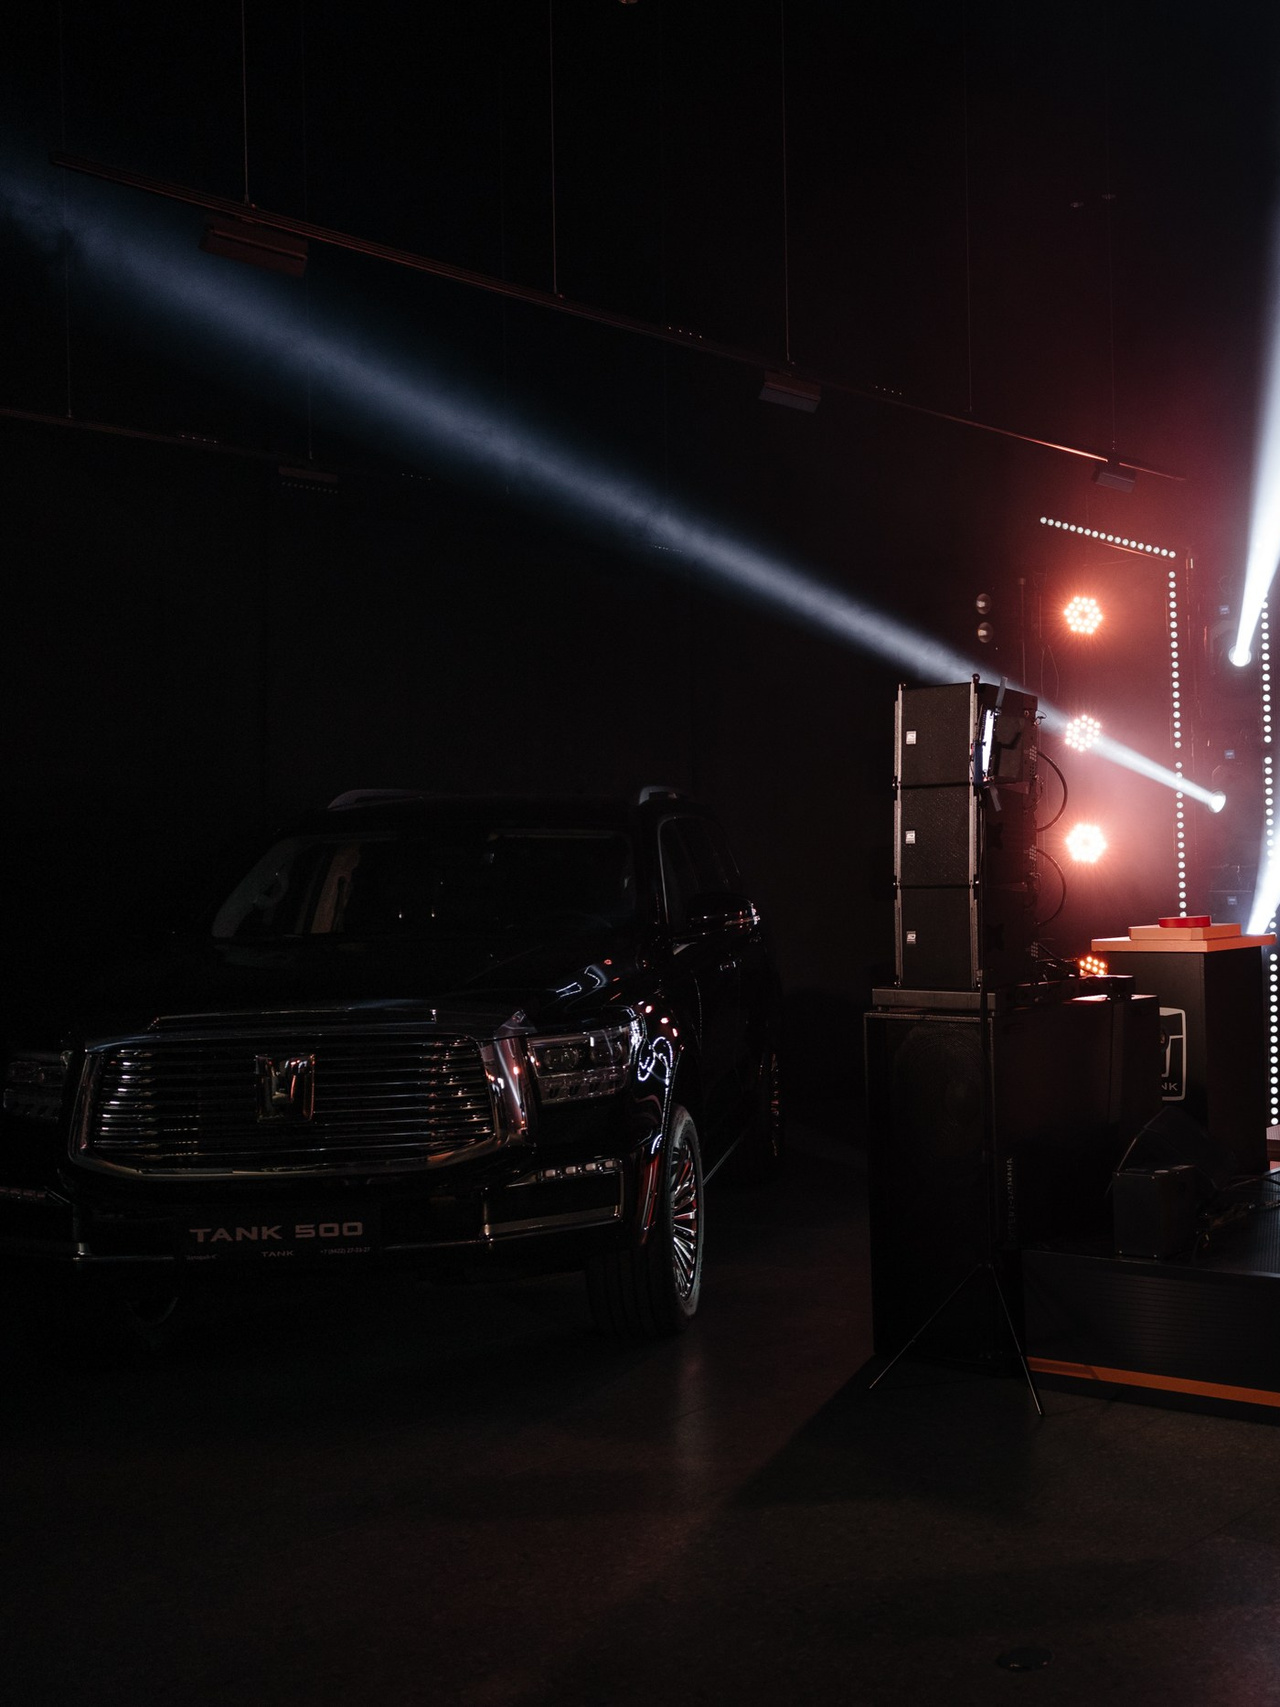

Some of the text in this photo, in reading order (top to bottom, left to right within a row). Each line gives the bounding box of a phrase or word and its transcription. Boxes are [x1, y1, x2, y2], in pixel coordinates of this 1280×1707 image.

[1161, 1081, 1178, 1091] NK
[188, 1221, 364, 1243] TANK 500
[261, 1250, 295, 1259] TANK
